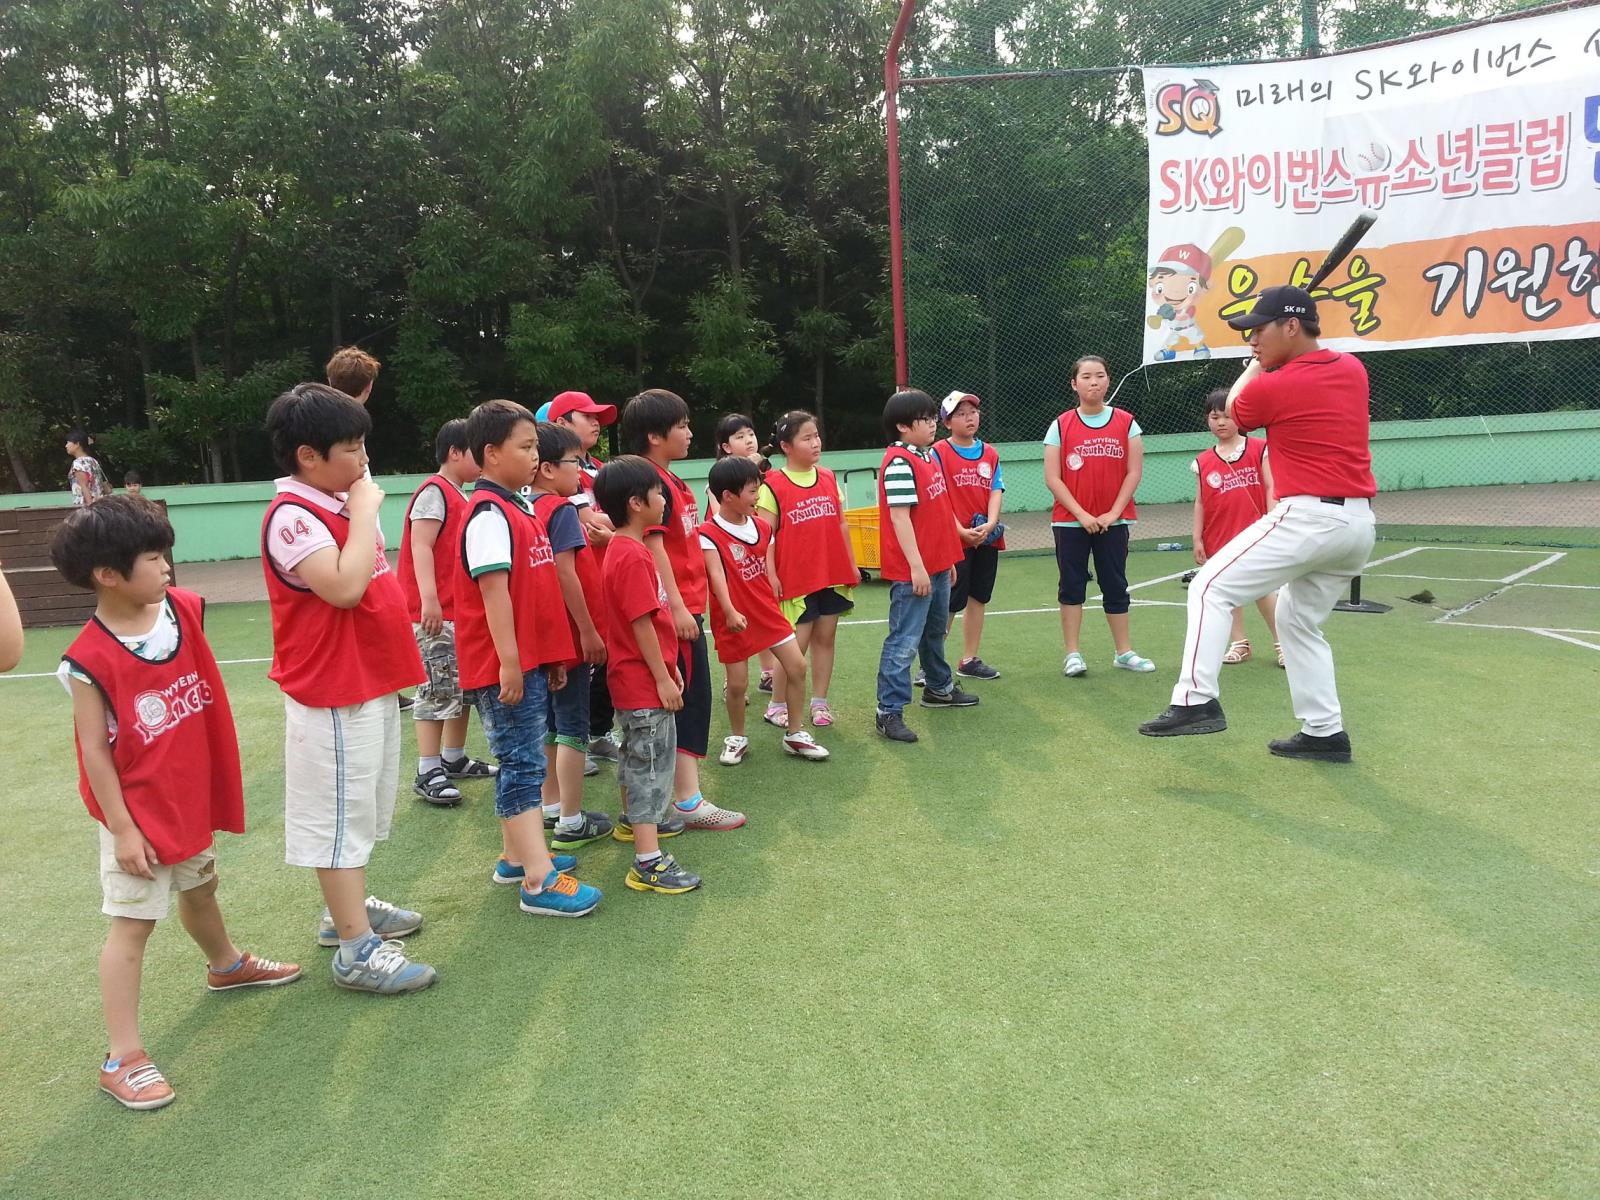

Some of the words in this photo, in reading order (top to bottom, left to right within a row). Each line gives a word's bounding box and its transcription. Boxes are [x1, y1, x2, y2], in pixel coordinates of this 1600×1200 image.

[1236, 79, 1333, 108] 미래의
[1355, 37, 1557, 101] SK와이번스
[1156, 80, 1223, 139] SQ
[1178, 249, 1191, 260] W
[1284, 305, 1295, 313] SK
[1104, 444, 1125, 459] Club
[280, 518, 311, 545] 04
